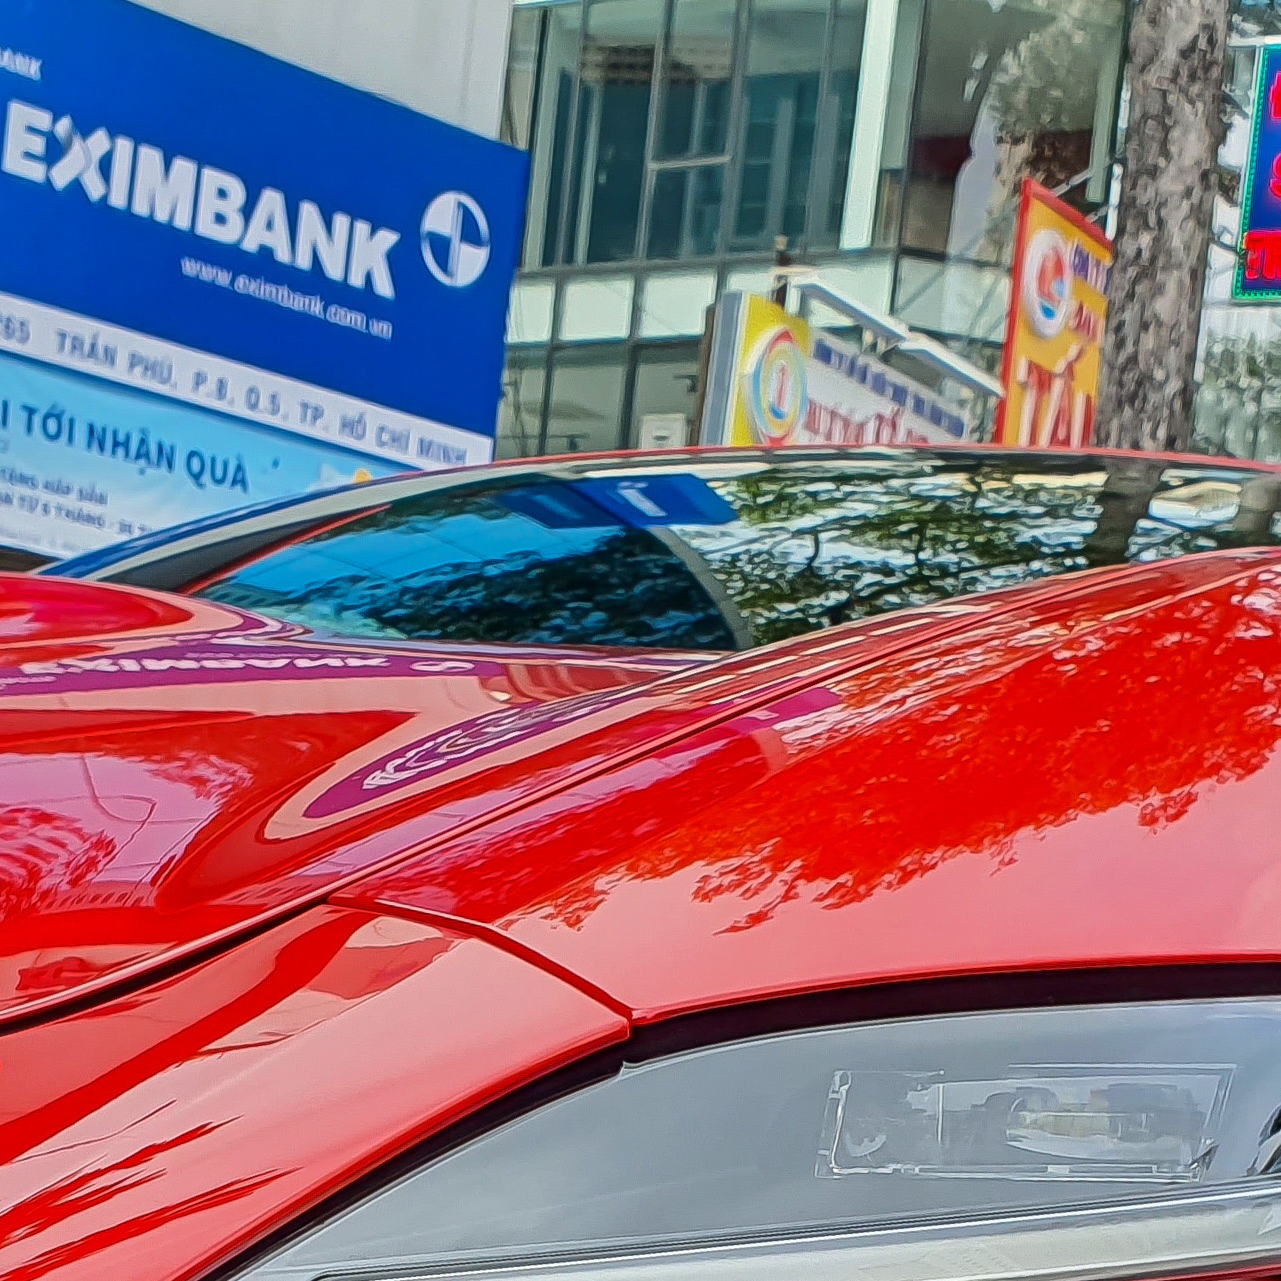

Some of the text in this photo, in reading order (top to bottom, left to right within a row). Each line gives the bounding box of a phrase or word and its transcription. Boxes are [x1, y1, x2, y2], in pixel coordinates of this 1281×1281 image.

[1, 99, 401, 299] EXIMBANK
[21, 403, 74, 446] TỚI
[87, 422, 176, 476] NHẬN
[186, 447, 249, 494] QUÀ
